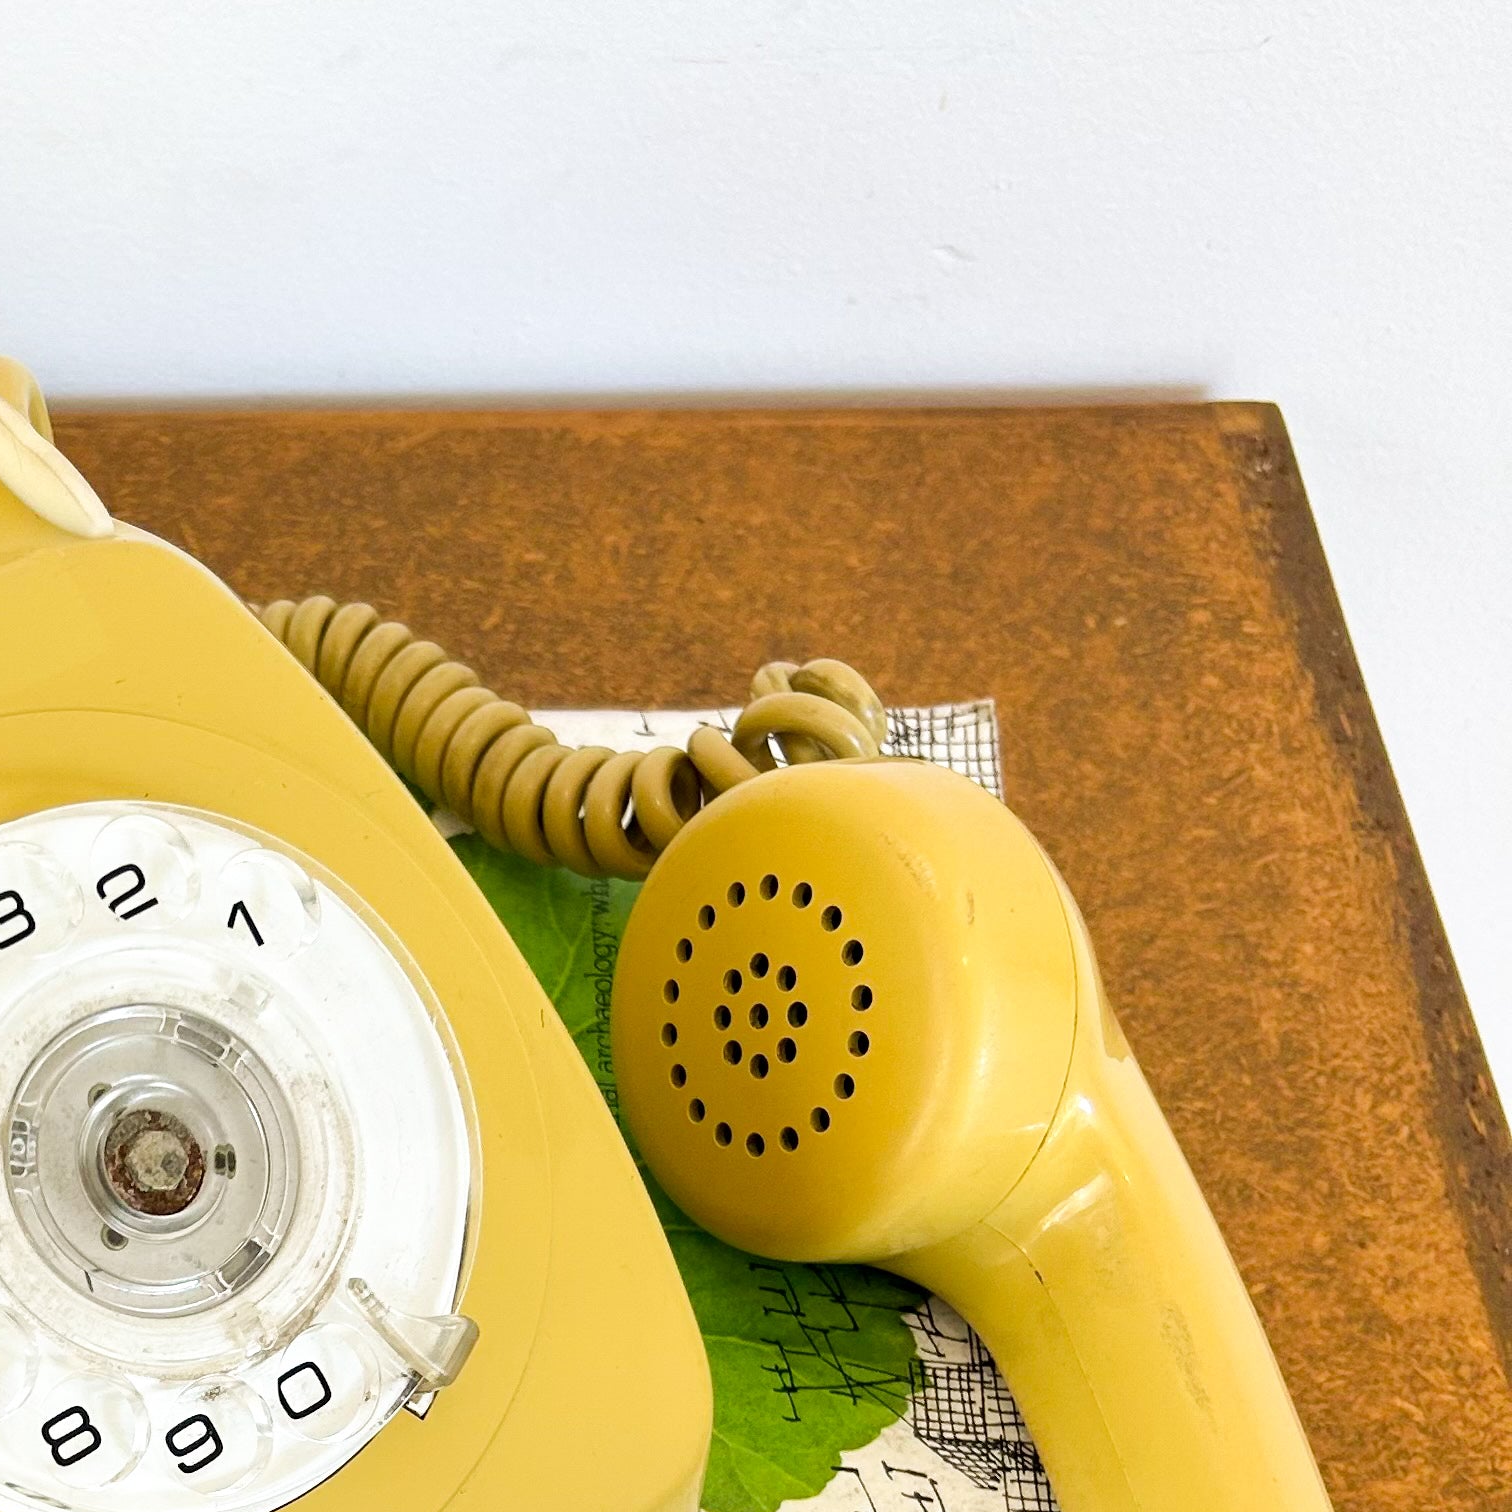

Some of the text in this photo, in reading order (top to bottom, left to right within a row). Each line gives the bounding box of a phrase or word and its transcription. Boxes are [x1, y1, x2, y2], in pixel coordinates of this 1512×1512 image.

[96, 864, 158, 921] 2
[227, 900, 265, 947] 1
[277, 1360, 332, 1419] 0
[42, 1405, 102, 1467] 8
[165, 1414, 224, 1475] 9
